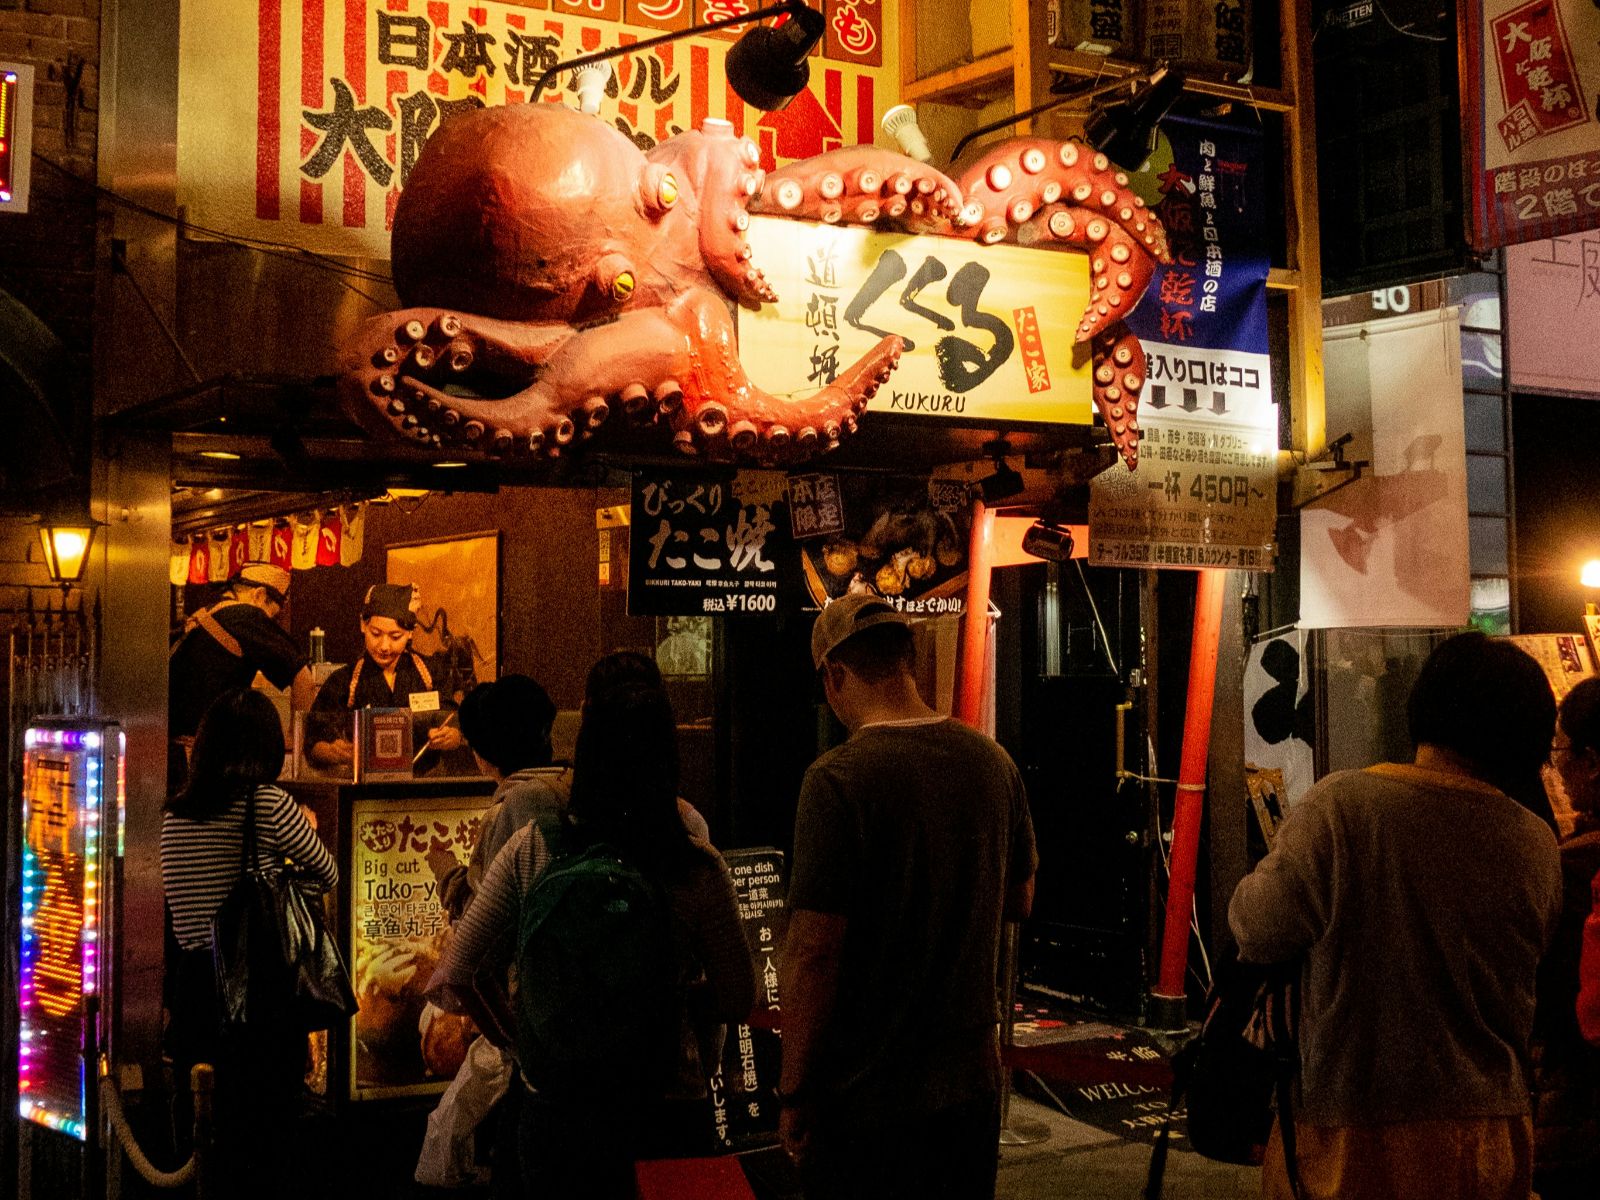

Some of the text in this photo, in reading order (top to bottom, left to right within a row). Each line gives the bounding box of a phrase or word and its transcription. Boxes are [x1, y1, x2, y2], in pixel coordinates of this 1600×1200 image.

[1502, 21, 1572, 112] 大阪に乾杯
[1199, 140, 1222, 313] 肉と鮮魚と日本酒の店
[804, 245, 842, 390] 道頓堀
[844, 249, 1015, 394] くくる
[1016, 308, 1050, 391] たこ家
[891, 390, 966, 414] KUKURU
[642, 480, 723, 517] びっくり
[648, 504, 778, 573] たこ焼
[671, 579, 702, 588] TAKO-YAKI
[364, 858, 421, 878] Big cut
[734, 865, 753, 876] one
[754, 861, 774, 874] dish
[748, 874, 780, 888] person
[364, 878, 438, 901] Tako-y
